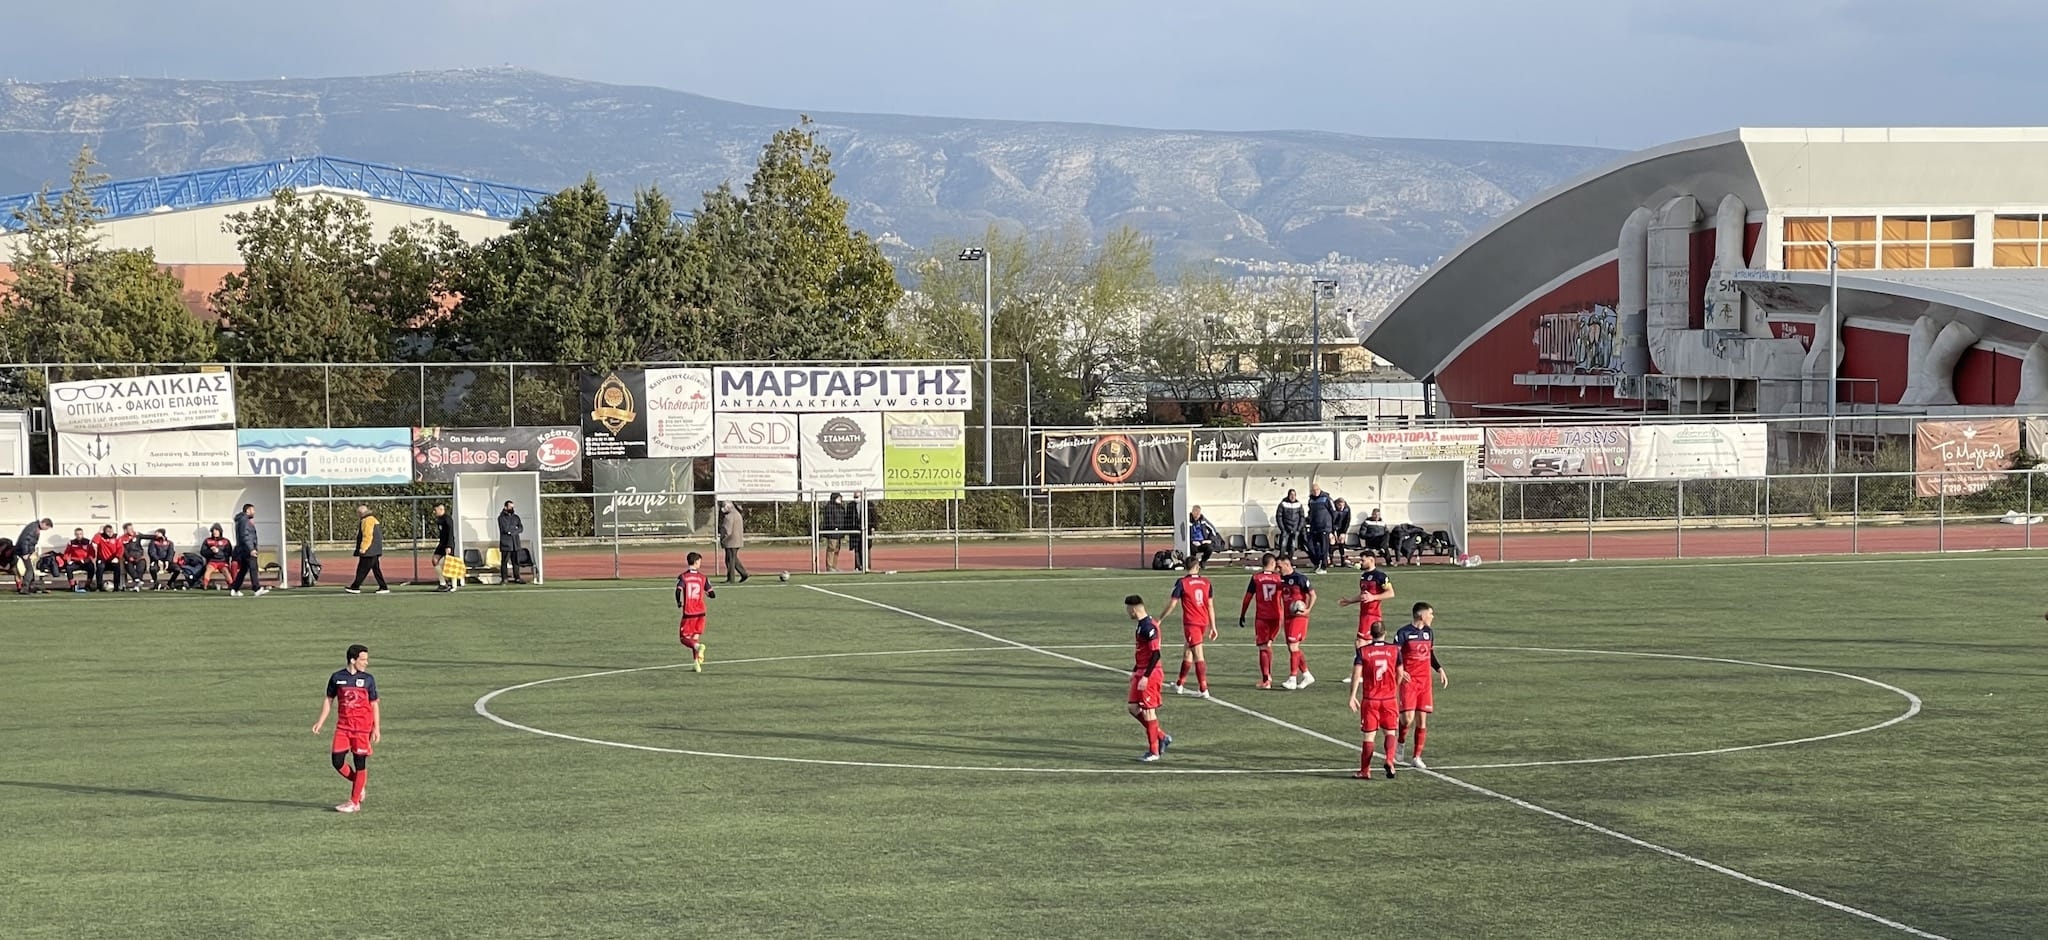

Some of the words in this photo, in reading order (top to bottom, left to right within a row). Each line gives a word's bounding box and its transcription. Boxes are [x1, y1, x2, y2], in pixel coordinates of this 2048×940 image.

[110, 376, 227, 398] ΧΑΛΙΚΙΑΣ
[721, 369, 967, 397] ΜΑΡΓΑΡΙΤΗΣ
[67, 403, 114, 416] ΟΠΤΙΚΑ
[125, 398, 165, 411] ΦΑΚΟΙ
[169, 395, 219, 408] ΕΠΑΦΗΣ
[720, 398, 861, 408] ΑΝΤΑΛΛΑΚΤΙΚΑ
[874, 398, 898, 407] VW
[910, 397, 967, 407] GROUP
[461, 435, 475, 443] line
[476, 435, 507, 445] delivery:
[537, 429, 574, 444] Κρέατα
[722, 421, 791, 445] ASD
[823, 434, 861, 443] ΣΤΑΜΑΤΗ
[1367, 431, 1439, 444] ΚΟΥΡΑΤΟΡΑΣ
[1496, 430, 1559, 446] SERVICE
[1564, 431, 1618, 444] TASSIS
[428, 447, 528, 467] Siakos.gr
[540, 443, 577, 460] Σιάκος
[1098, 453, 1131, 465] Θωμάς
[1528, 447, 1580, 455] ΗΛΕΚΤΡΟΛΟΓΕΙΟ
[1931, 440, 1956, 461] Το
[1956, 441, 2005, 469] Μαγκάλι
[248, 451, 308, 475] νησί
[888, 468, 962, 479] 210.57.17.016
[687, 582, 701, 599] 12
[1195, 589, 1204, 606] 9
[1262, 583, 1277, 602] 17
[1375, 660, 1388, 681] 7
